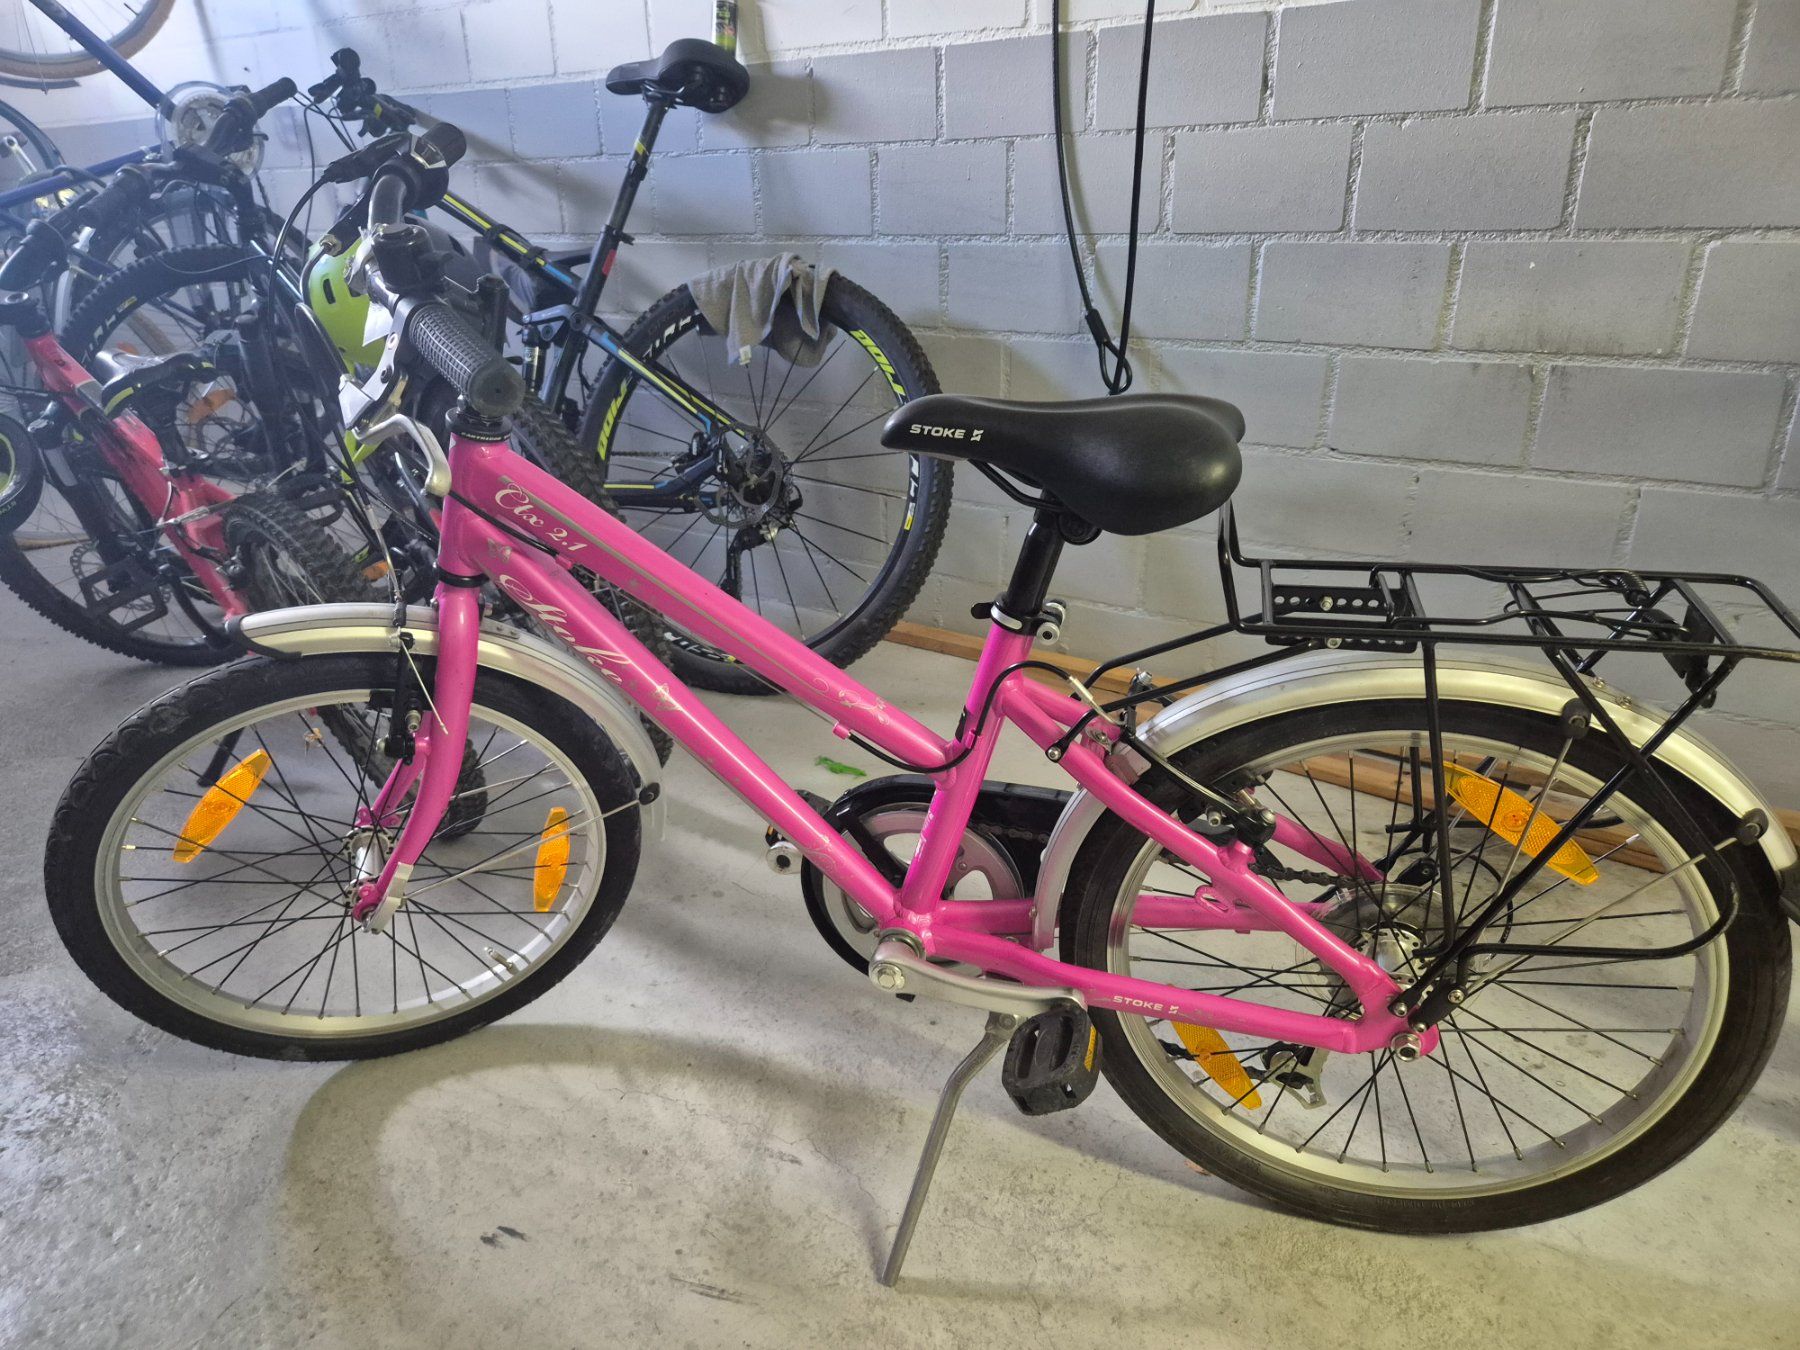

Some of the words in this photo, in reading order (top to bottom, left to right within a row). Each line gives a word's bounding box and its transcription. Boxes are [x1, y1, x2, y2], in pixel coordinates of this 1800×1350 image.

[909, 424, 966, 439] STOKE
[546, 528, 587, 551] 2.1
[1113, 995, 1163, 1011] STOKE
